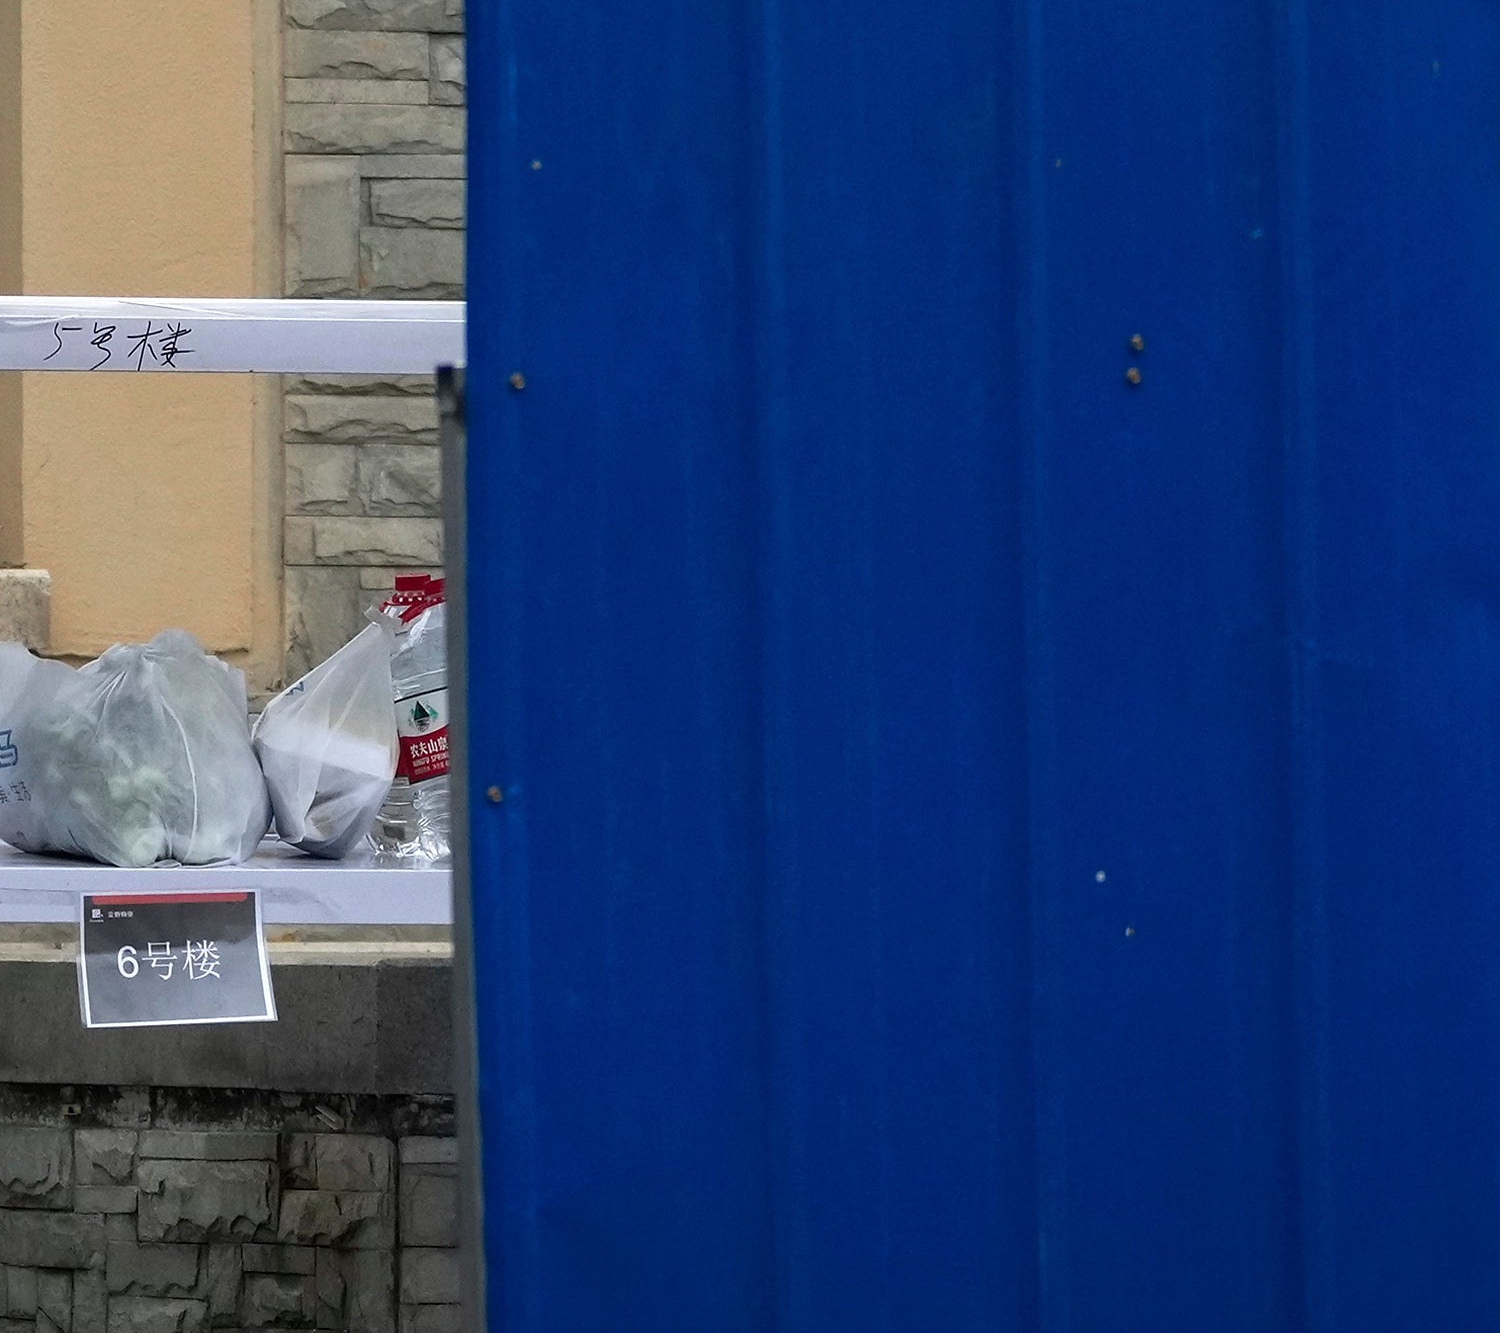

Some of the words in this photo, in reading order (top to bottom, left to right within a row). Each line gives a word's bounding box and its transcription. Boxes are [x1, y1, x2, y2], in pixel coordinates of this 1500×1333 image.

[410, 736, 449, 758] 农夫山泉
[116, 939, 222, 981] 6号楼
